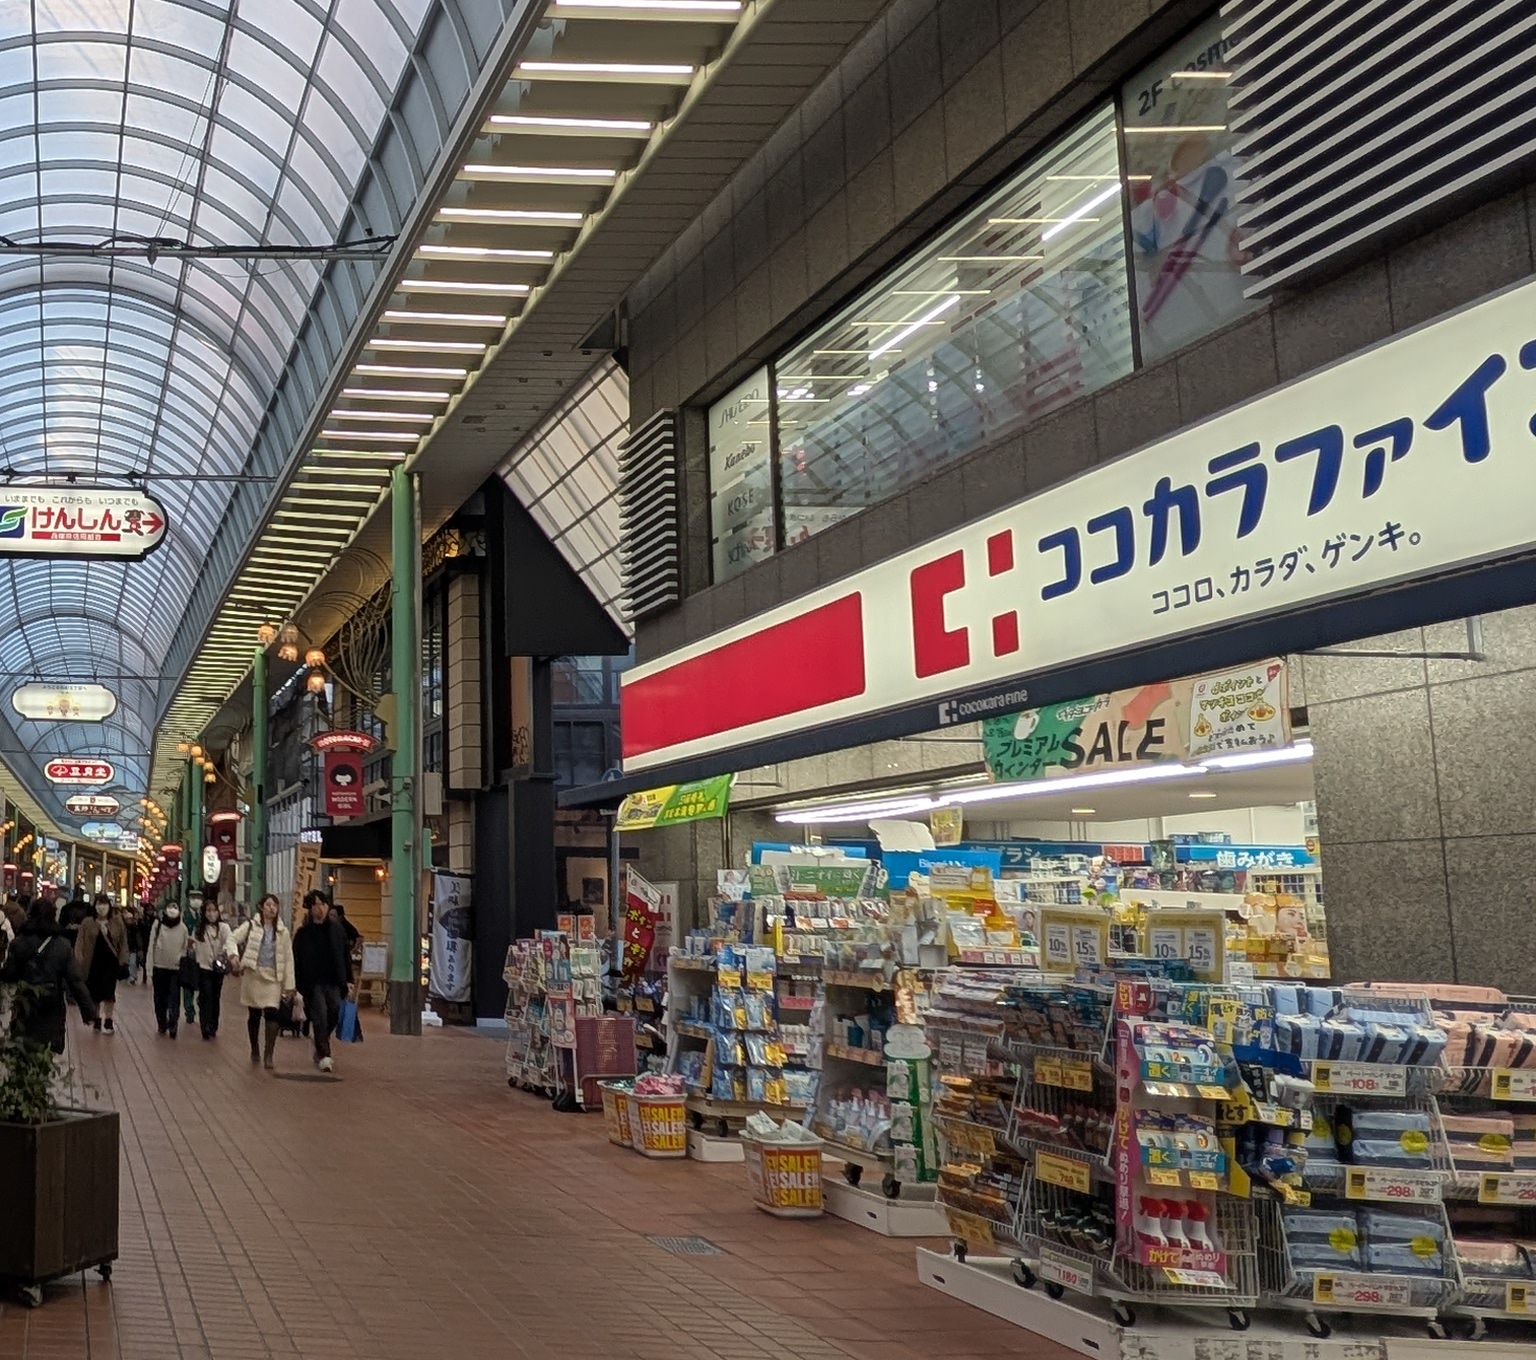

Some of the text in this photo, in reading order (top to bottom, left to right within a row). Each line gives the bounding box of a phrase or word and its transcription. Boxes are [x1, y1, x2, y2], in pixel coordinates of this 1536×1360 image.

[1138, 79, 1164, 117] 2F
[723, 442, 757, 471] Kanebo
[1038, 338, 1536, 602] ココカラファイ
[4, 495, 139, 506] いままでも これからも いつまでも
[31, 506, 122, 531] けんしん
[1151, 521, 1422, 615] ココロ、カラダ、ゲンキ。
[996, 733, 1061, 759] プレミアム
[1060, 717, 1166, 771] SALE
[994, 757, 1058, 779] ウィンター
[1216, 849, 1296, 870] 歯みがき
[1351, 1078, 1376, 1091] 108
[1386, 1185, 1412, 1197] 298
[1518, 1189, 1536, 1201] 29
[1354, 1290, 1380, 1303] 298
